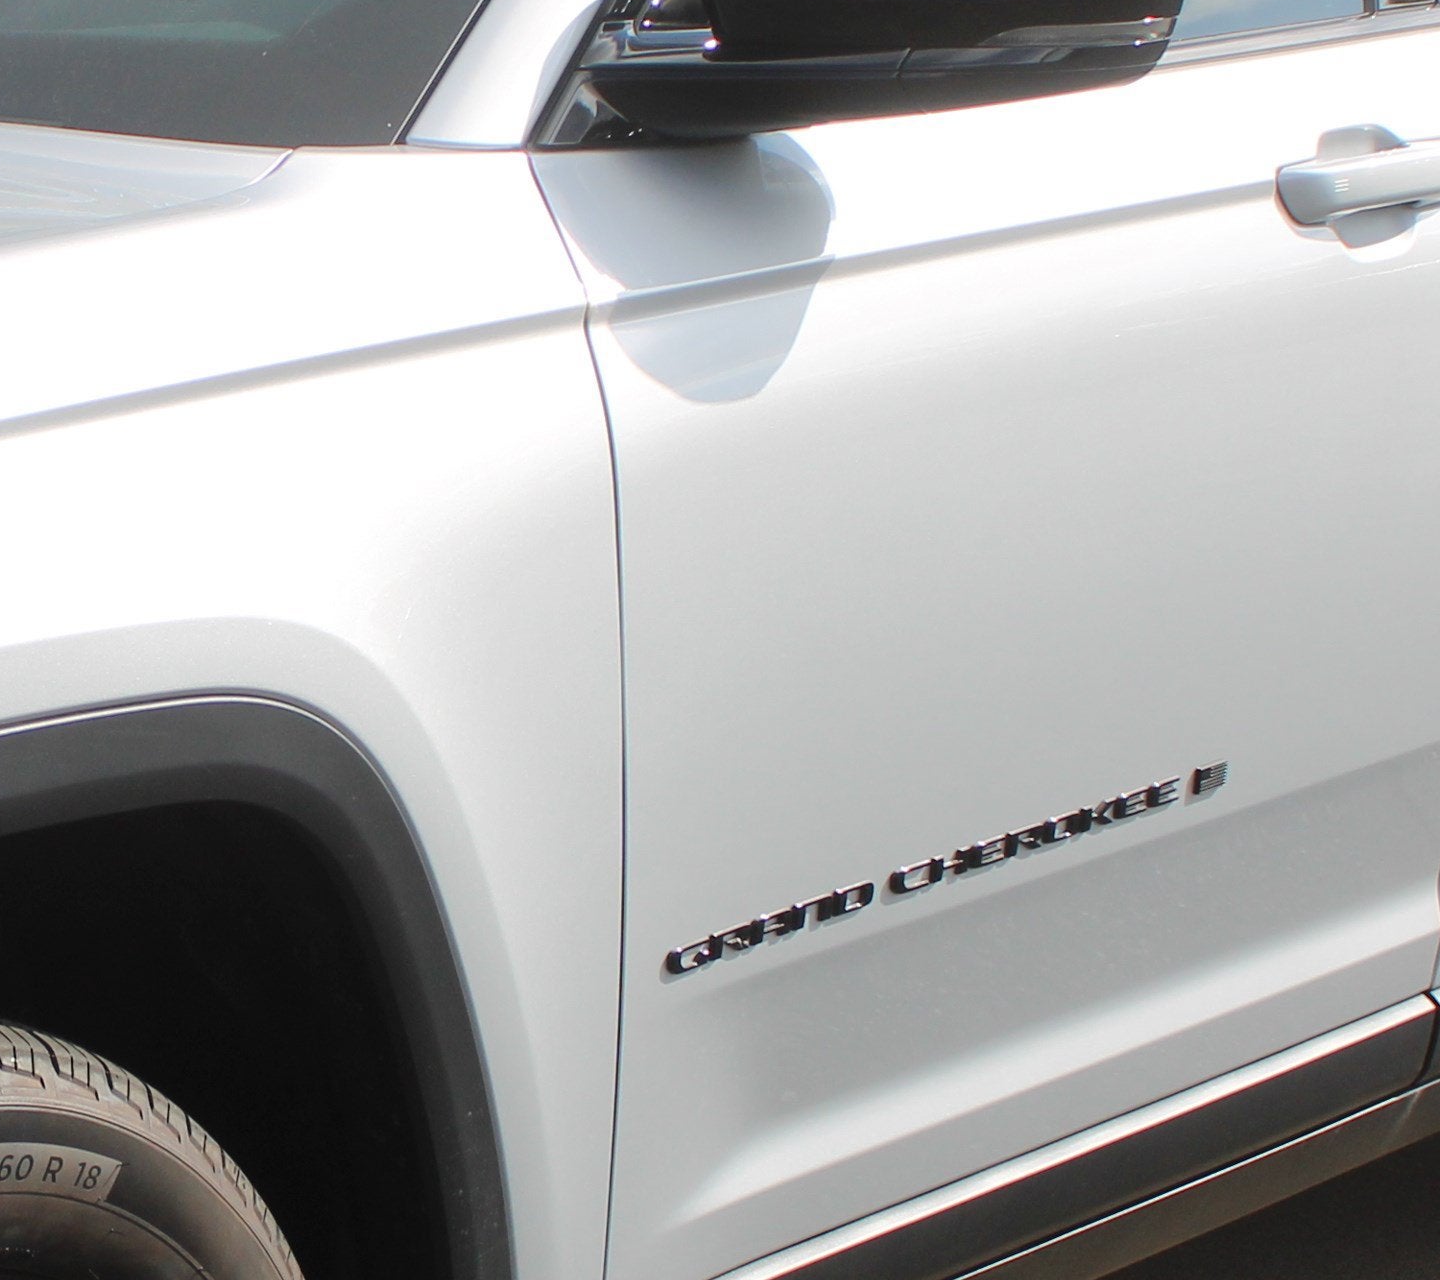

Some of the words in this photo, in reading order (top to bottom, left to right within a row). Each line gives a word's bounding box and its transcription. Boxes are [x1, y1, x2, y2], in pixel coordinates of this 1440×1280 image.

[665, 879, 875, 976] GRAND
[889, 774, 1181, 895] CHEROKEE
[41, 1156, 64, 1183] R
[73, 1162, 102, 1190] 18
